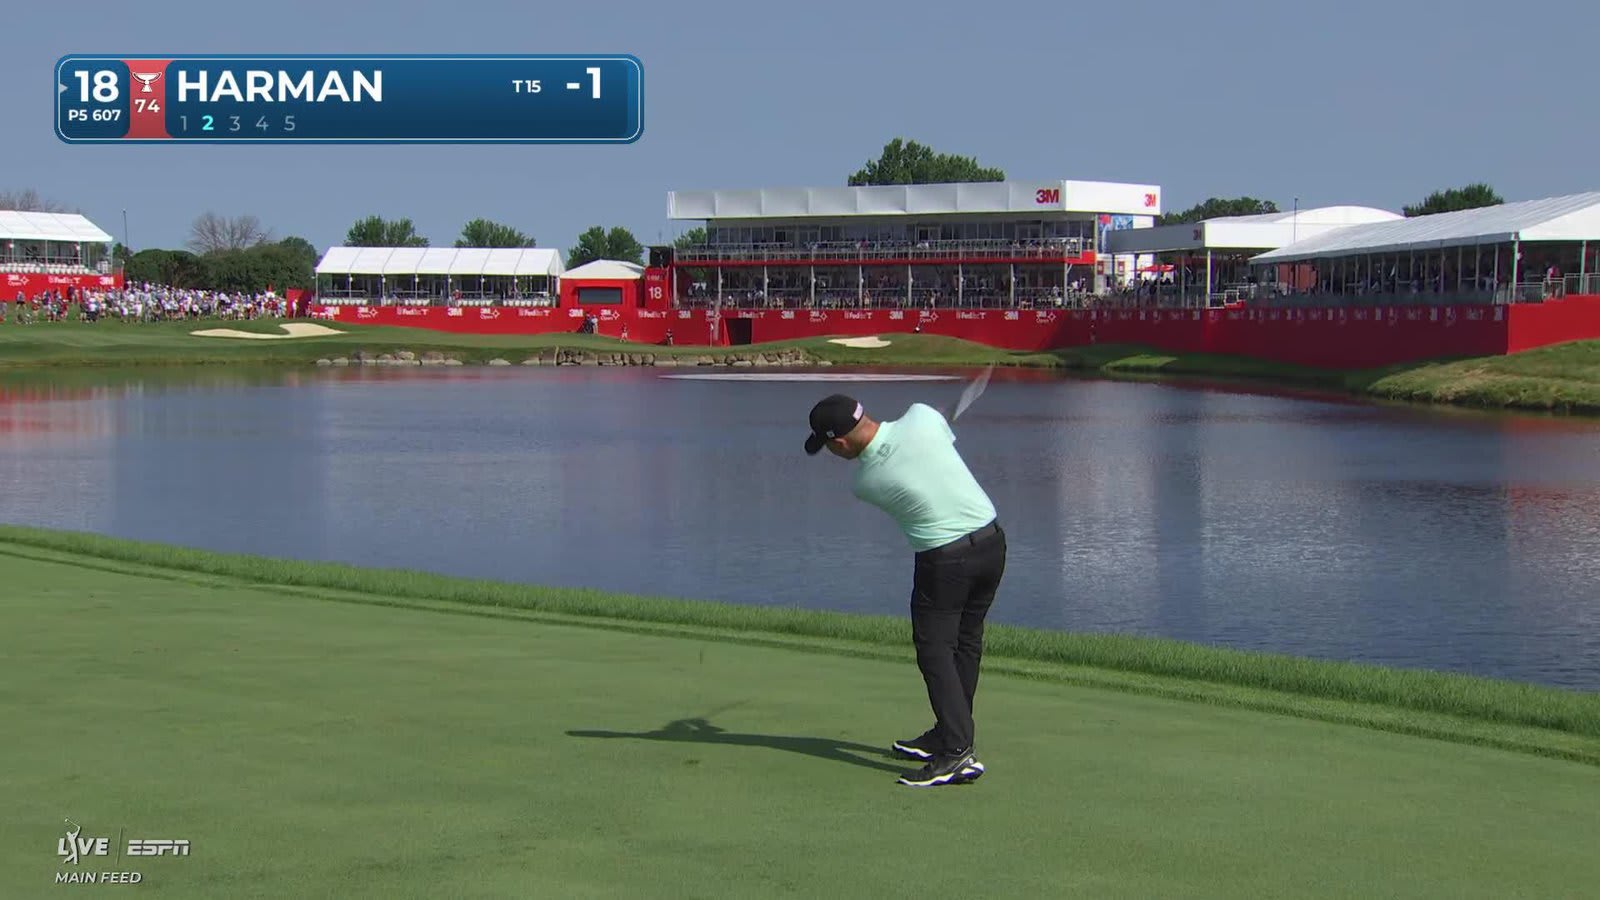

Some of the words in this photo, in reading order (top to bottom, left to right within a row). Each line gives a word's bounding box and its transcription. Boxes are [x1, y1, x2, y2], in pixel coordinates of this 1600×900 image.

[1036, 189, 1060, 203] 3M
[1144, 193, 1156, 207] 3M
[649, 286, 662, 300] 18
